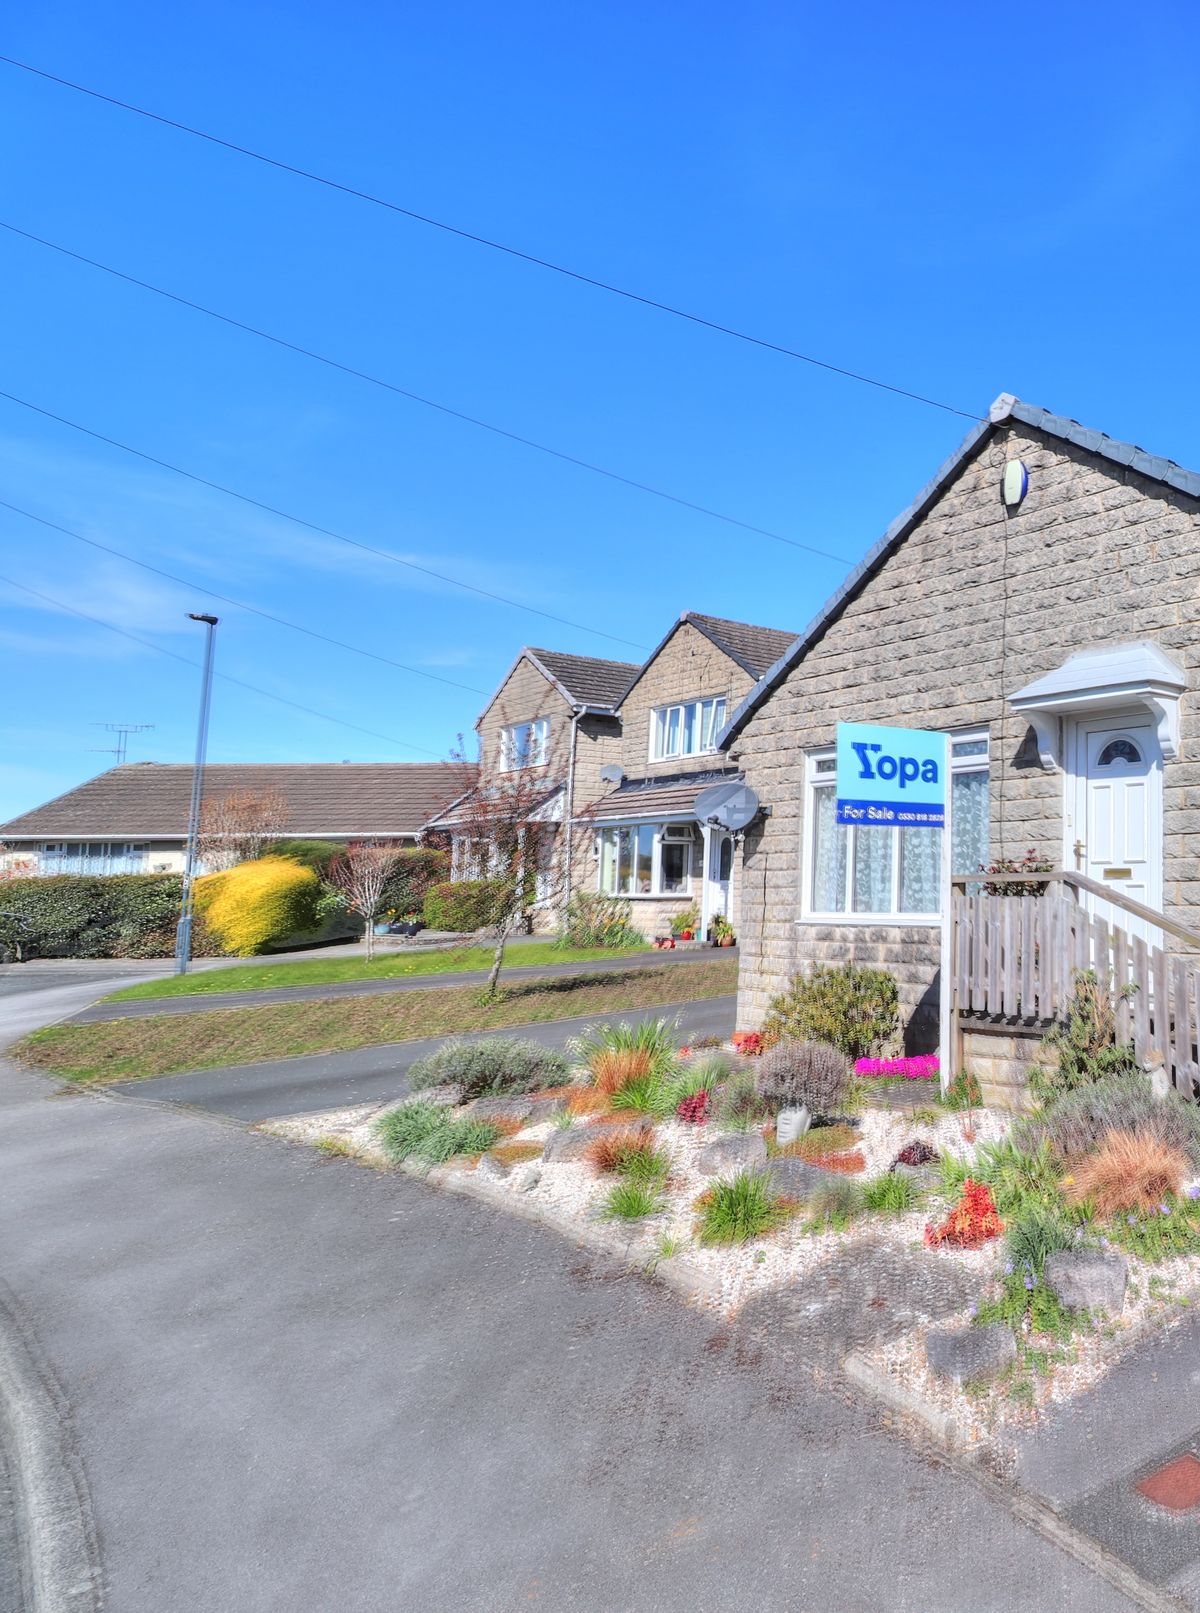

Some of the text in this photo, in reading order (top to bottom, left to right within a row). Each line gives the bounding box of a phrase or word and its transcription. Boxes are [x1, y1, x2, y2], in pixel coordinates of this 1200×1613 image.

[851, 741, 938, 789] Yopa
[843, 805, 866, 819] For
[867, 805, 895, 820] Sale
